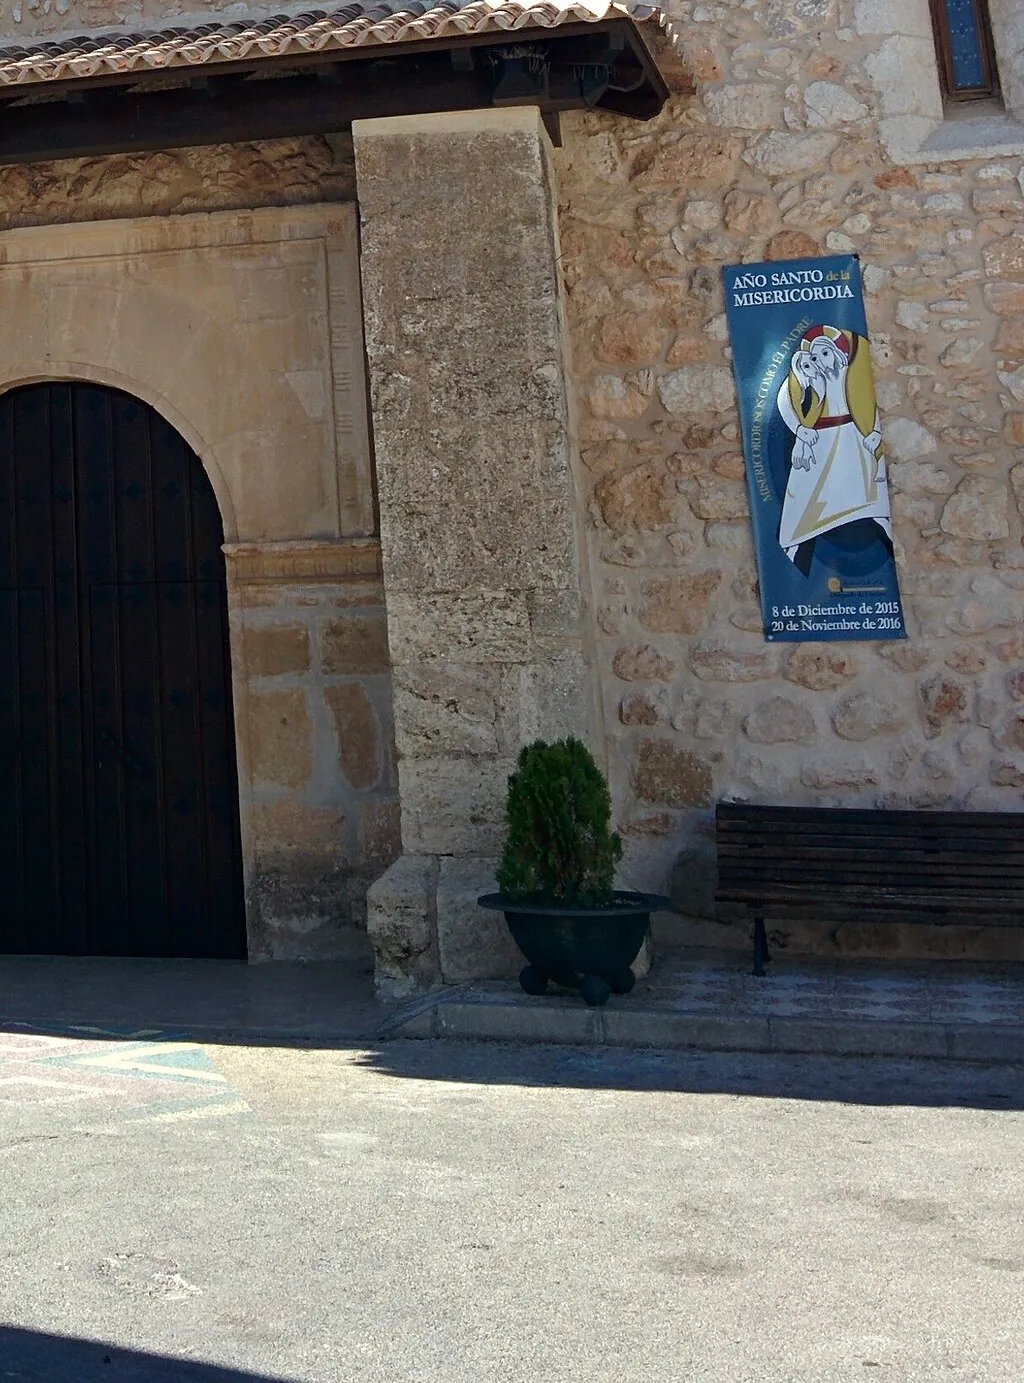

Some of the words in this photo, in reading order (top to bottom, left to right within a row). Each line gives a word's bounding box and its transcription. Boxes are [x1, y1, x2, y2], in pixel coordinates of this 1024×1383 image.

[733, 273, 767, 289] AÑO
[772, 270, 824, 286] SANTO
[826, 270, 839, 282] de
[841, 269, 851, 281] la
[733, 284, 855, 307] MISERICORDIA
[758, 362, 778, 398] COMO
[772, 348, 788, 364] EL
[781, 316, 814, 350] PADRE
[772, 605, 779, 617] 8
[781, 605, 795, 617] de
[797, 603, 856, 617] Diciembre
[859, 602, 873, 614] de
[874, 602, 900, 614] 2015
[771, 620, 784, 632] 20
[786, 620, 799, 631] de
[800, 618, 861, 631] Noviembre
[862, 618, 876, 630] de
[877, 617, 901, 630] 2016
